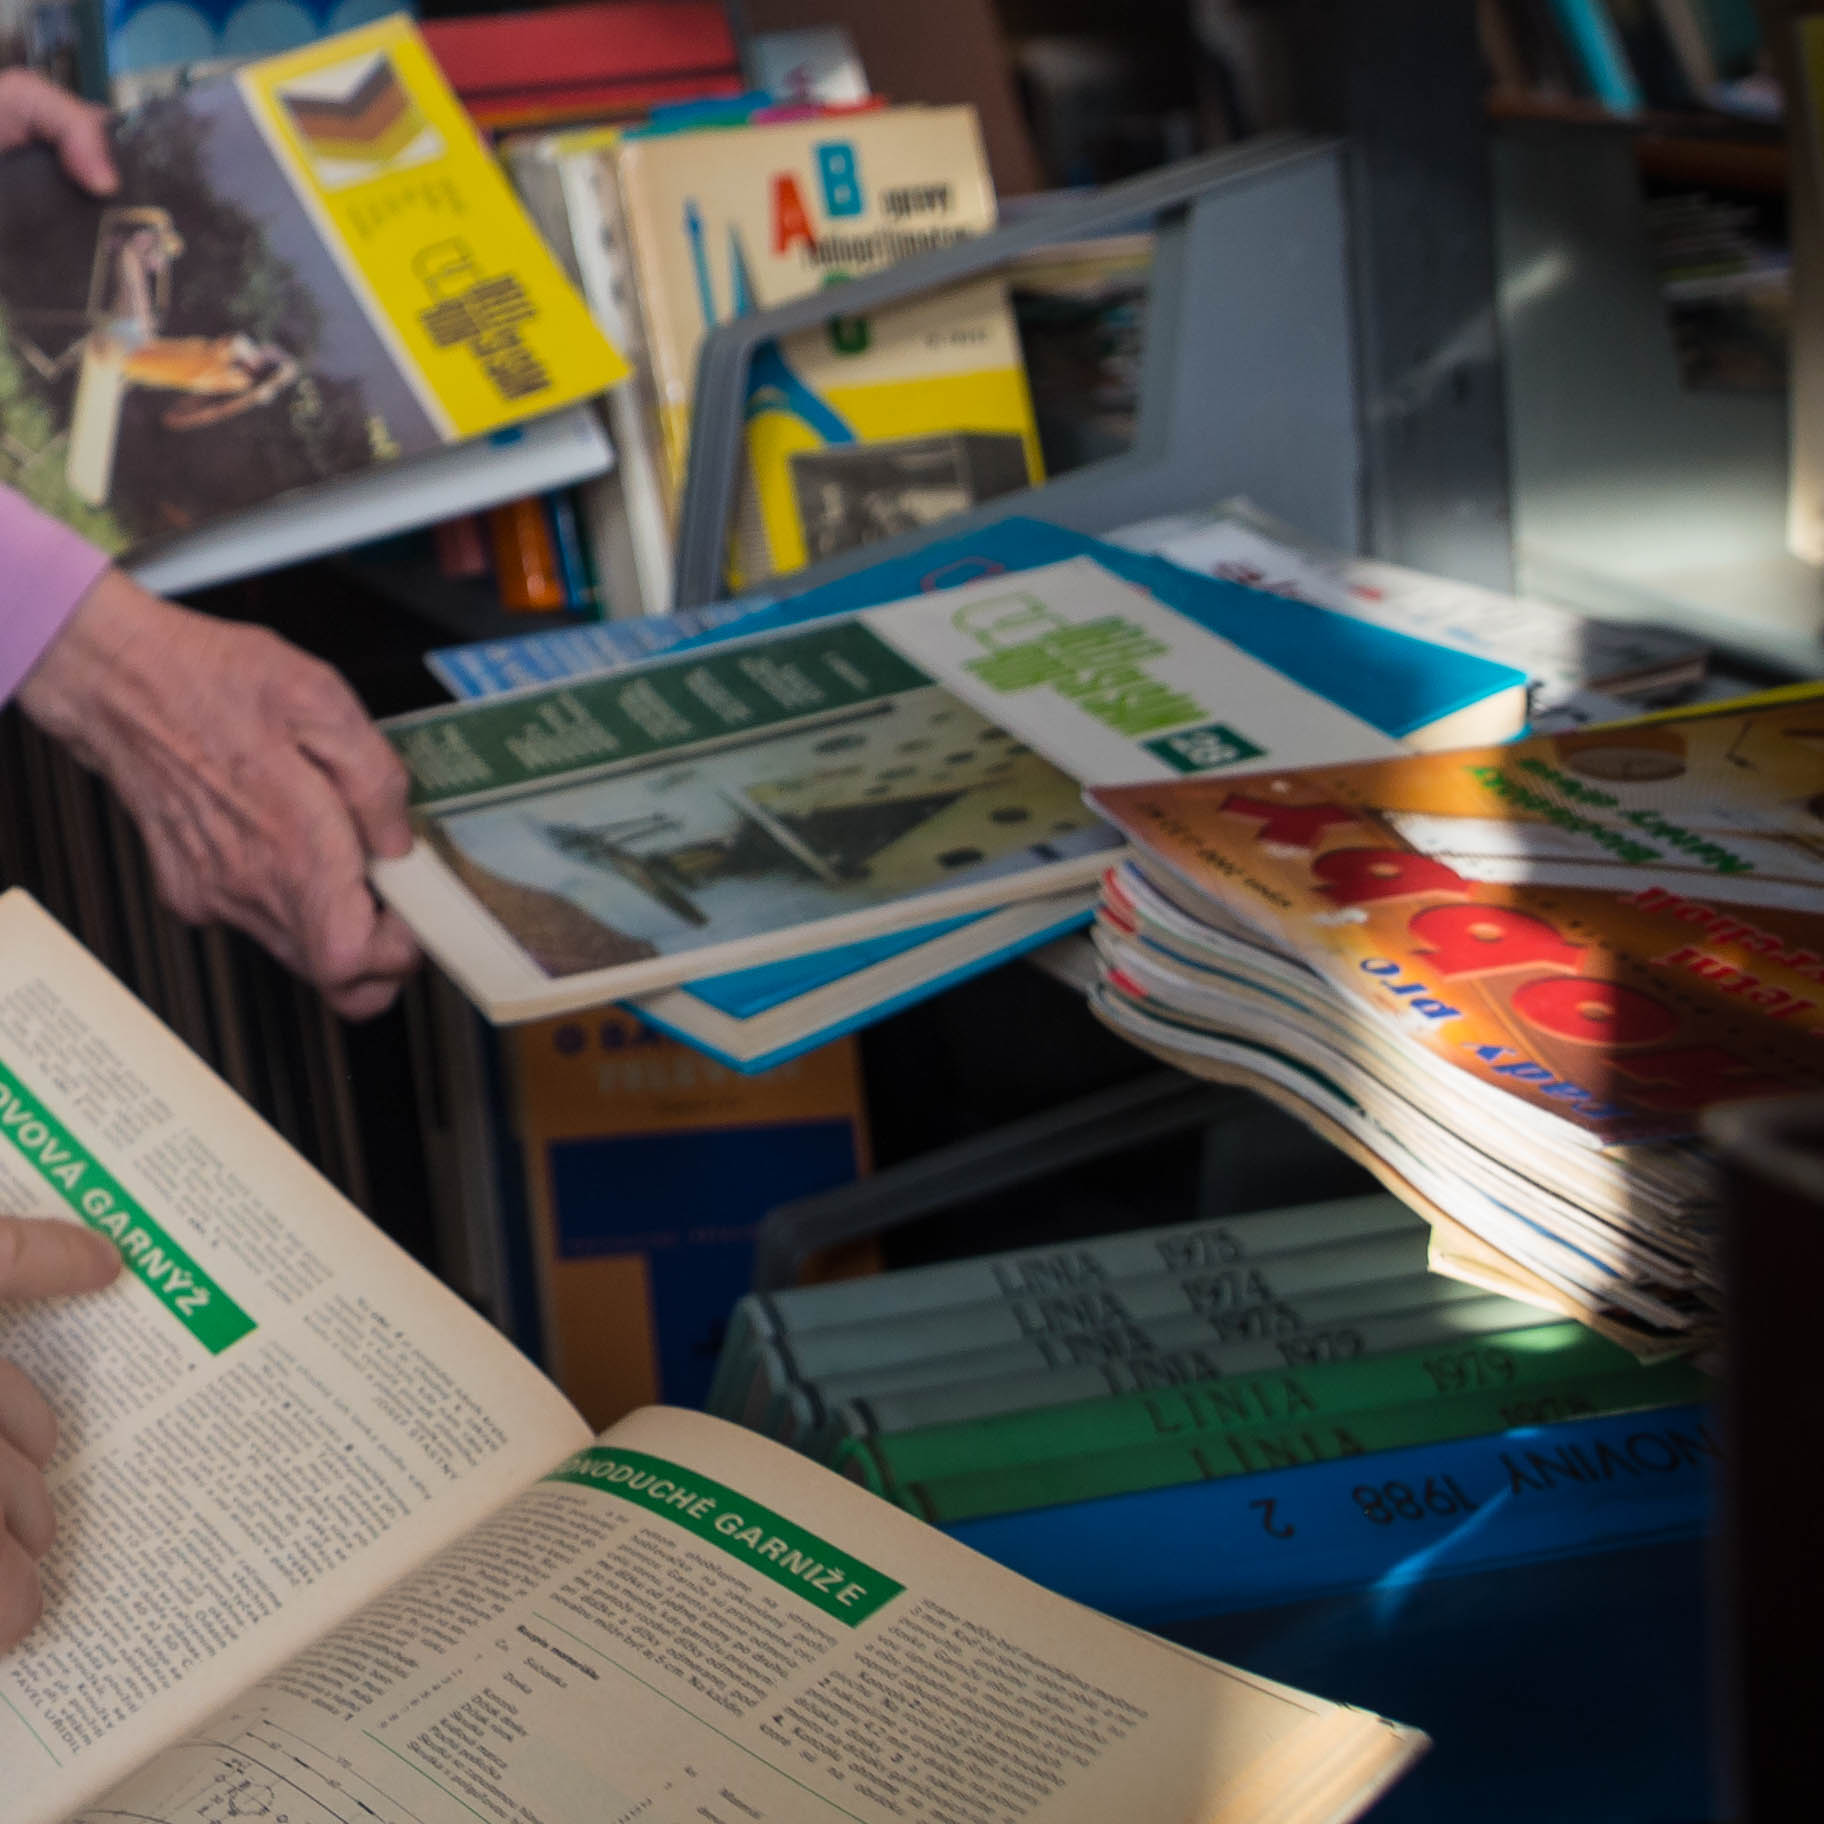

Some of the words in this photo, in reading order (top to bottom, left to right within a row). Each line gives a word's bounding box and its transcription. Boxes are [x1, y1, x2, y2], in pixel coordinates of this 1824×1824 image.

[1361, 957, 1462, 1021] pro
[79, 1186, 215, 1322] GARNÝŽ
[1253, 1497, 1295, 1540] 2
[1353, 1474, 1475, 1525] 1988
[707, 1494, 868, 1612] GARNIŽE
